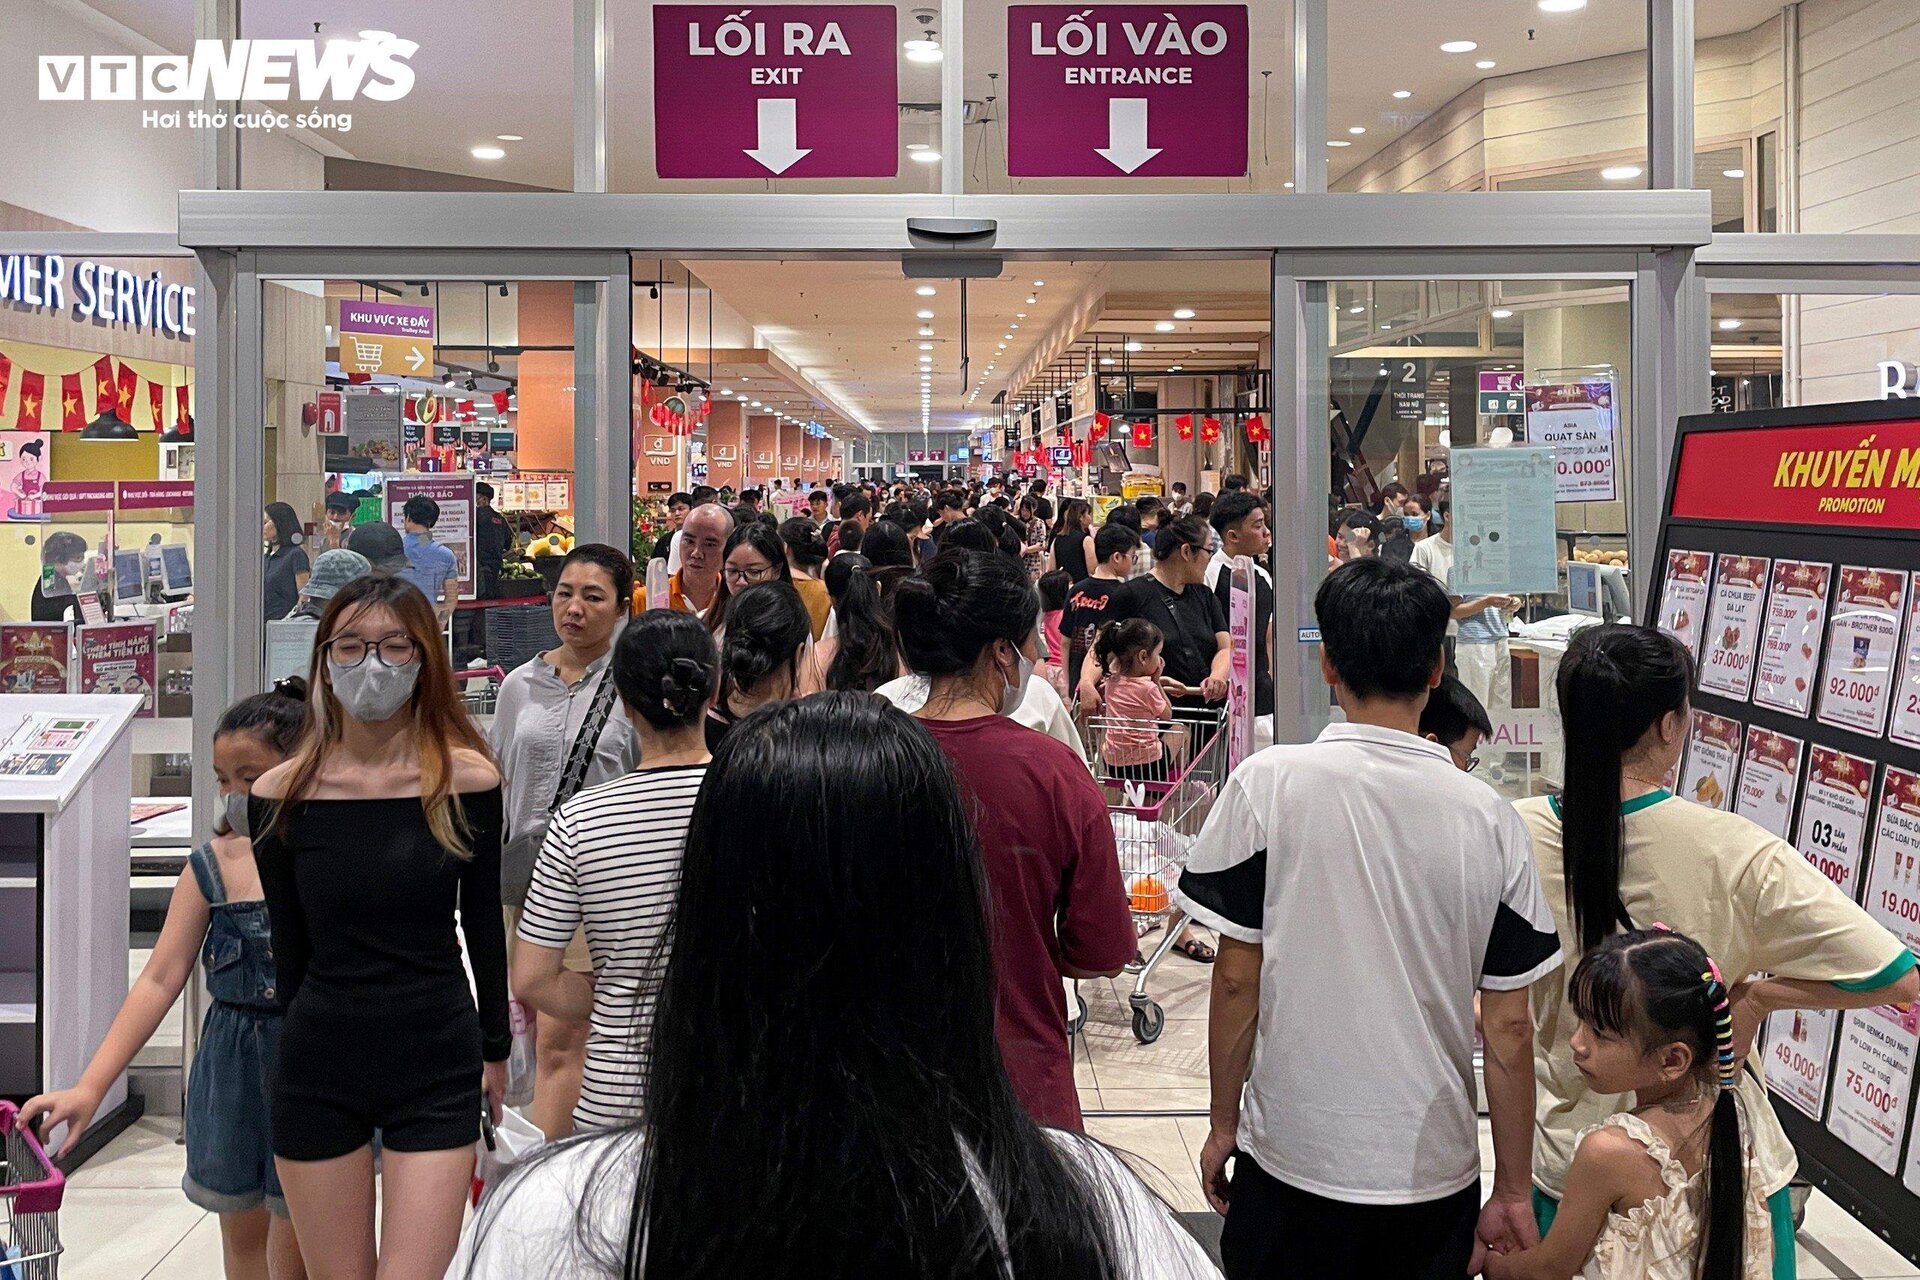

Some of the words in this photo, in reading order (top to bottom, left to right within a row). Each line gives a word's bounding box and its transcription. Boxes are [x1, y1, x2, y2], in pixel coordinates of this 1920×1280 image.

[688, 10, 766, 57] LỐI
[783, 22, 851, 57] RA
[1031, 8, 1109, 56] LỐI
[1121, 11, 1228, 57] VÀO
[750, 67, 803, 85] EXIT
[1065, 67, 1193, 85] ENTRANCE
[350, 312, 373, 324] KHU
[374, 314, 395, 327] VỰC
[397, 316, 409, 327] XE
[1402, 362, 1416, 383] 2
[1544, 433, 1573, 443] QUẠT
[1576, 430, 1597, 440] SÀN
[426, 460, 434, 472] 1
[478, 460, 485, 471] 3
[650, 457, 671, 465] VND
[1773, 434, 1891, 488] KHUYẾN
[436, 489, 454, 498] BÁO
[1818, 497, 1885, 513] PROMOTION
[1851, 622, 1878, 634] BROTHER
[1812, 819, 1833, 848] 03
[1881, 889, 1920, 924] 19.00
[1866, 1022, 1885, 1043] SENKA
[1859, 1038, 1872, 1054] LOW
[1872, 1047, 1881, 1060] PH
[1881, 1052, 1908, 1076] CALMING
[1862, 1060, 1876, 1076] CICA
